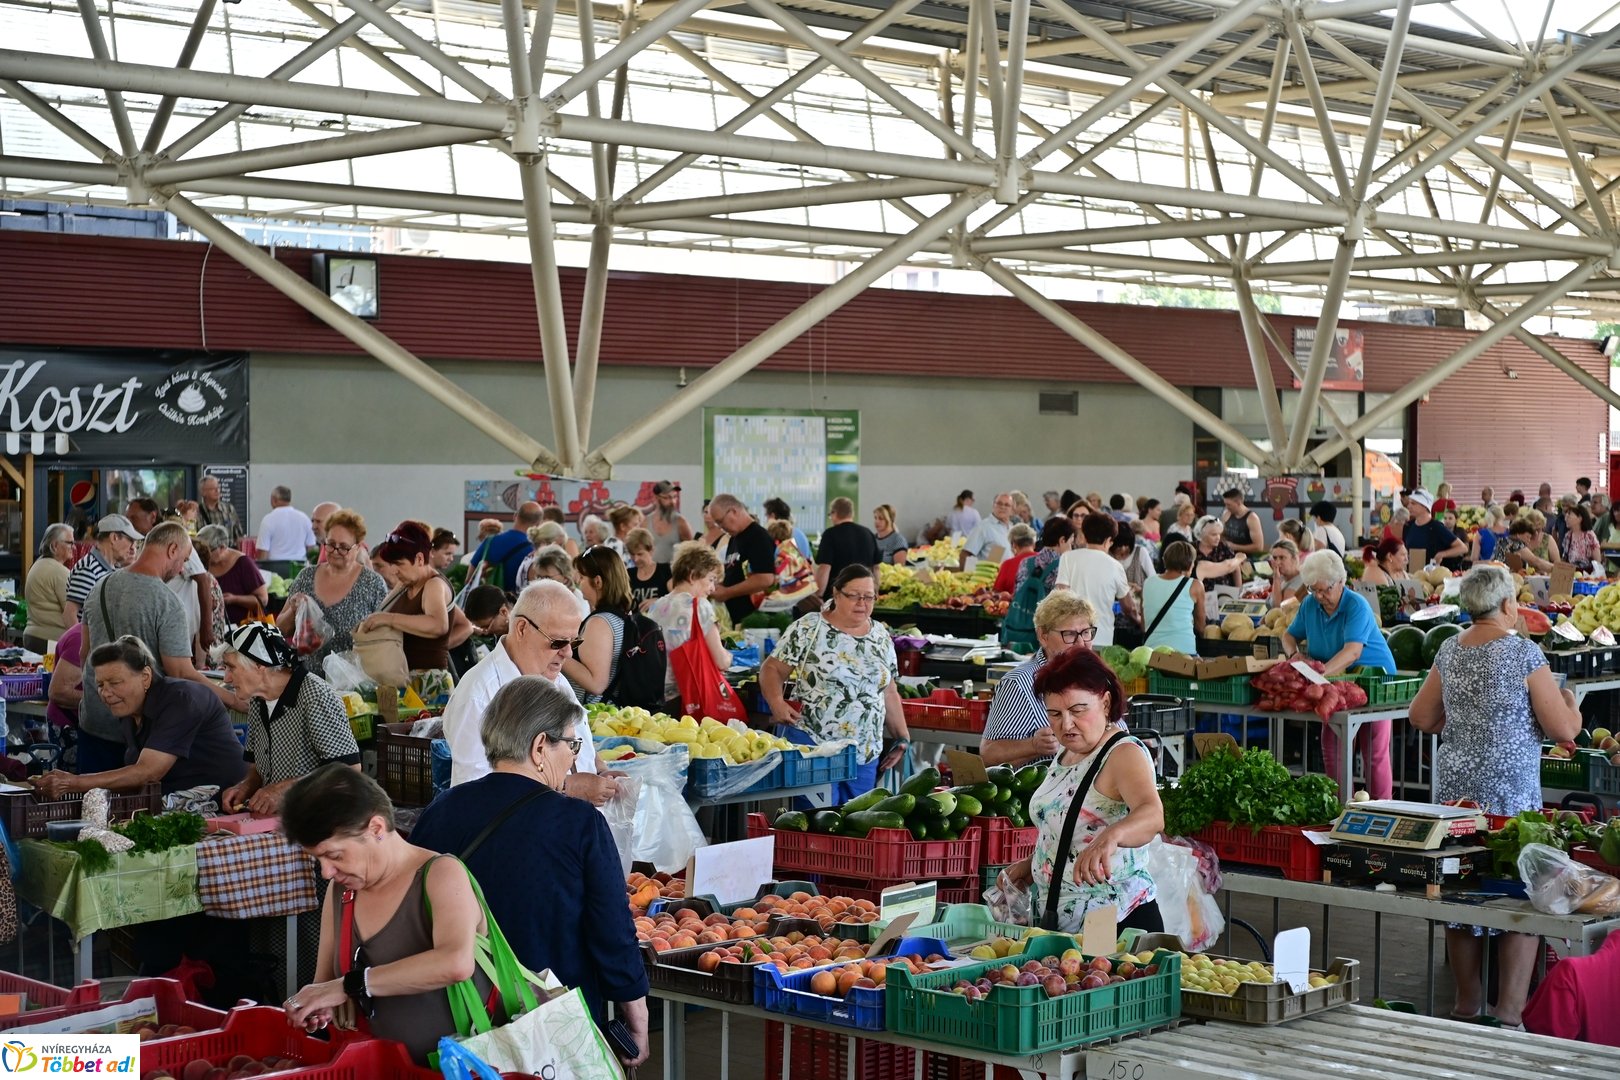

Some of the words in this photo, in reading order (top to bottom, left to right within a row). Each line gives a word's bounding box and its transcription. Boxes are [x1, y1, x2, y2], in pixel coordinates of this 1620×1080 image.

[0, 359, 142, 433] Koszt
[1326, 857, 1351, 867] Fruitona
[1400, 868, 1427, 879] Fruitona
[1109, 1060, 1145, 1080] 150
